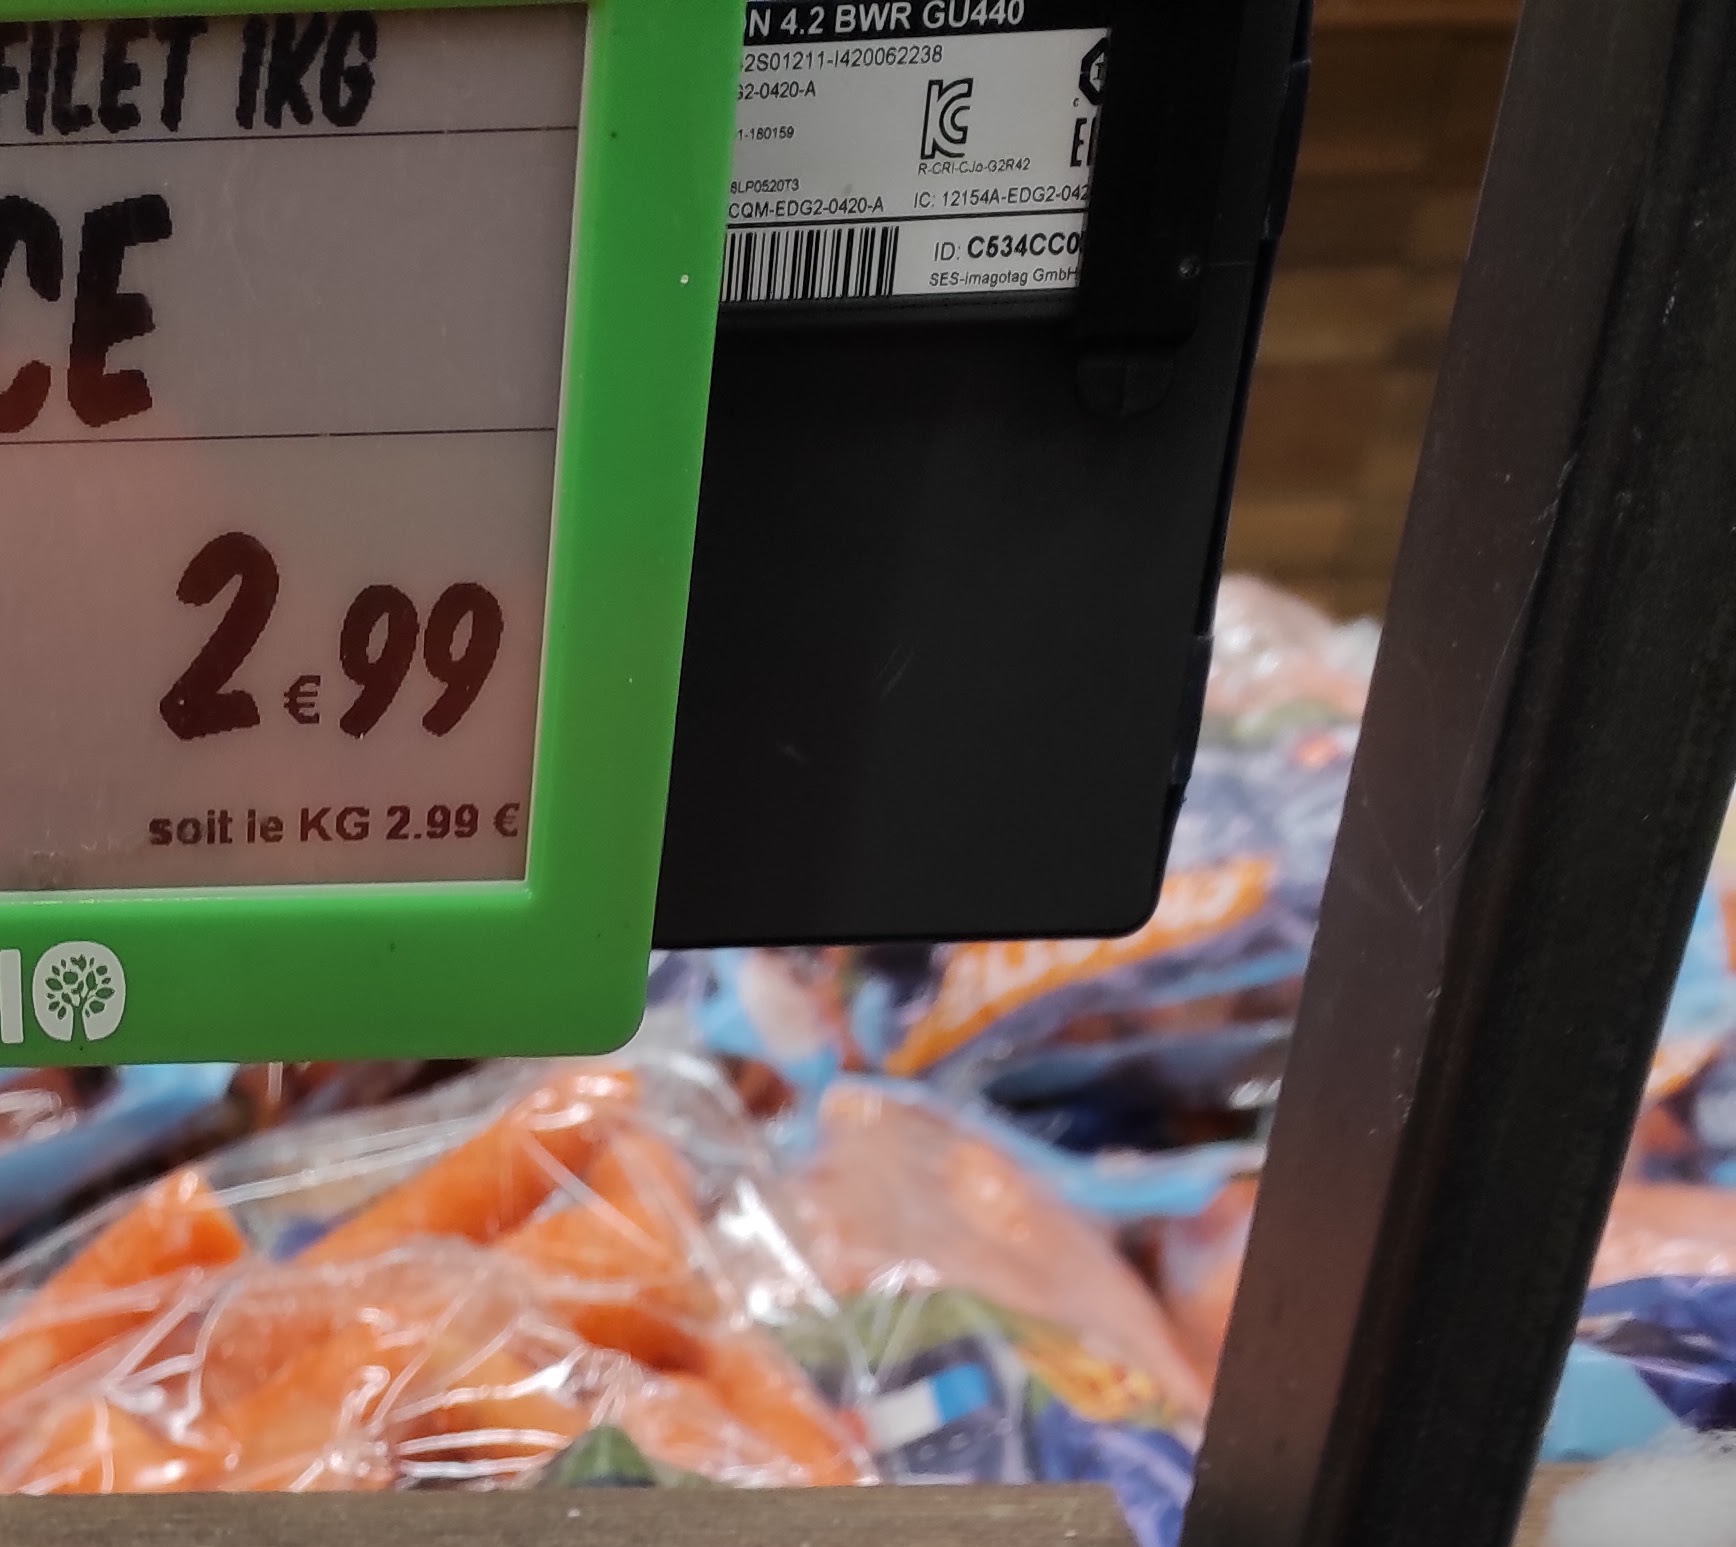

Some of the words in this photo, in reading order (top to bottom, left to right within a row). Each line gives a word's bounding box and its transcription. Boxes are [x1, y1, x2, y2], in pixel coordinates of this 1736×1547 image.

[745, 8, 771, 37] N
[780, 6, 824, 35] 4.2
[835, 2, 912, 33] BWR
[922, 0, 1024, 27] GU440
[934, 241, 961, 262] ID:
[929, 269, 1028, 287] SES-imagotag
[148, 809, 233, 845] soit
[246, 808, 284, 844] le
[300, 806, 370, 842] KG
[385, 803, 479, 840] 2.99
[493, 802, 521, 838] €
